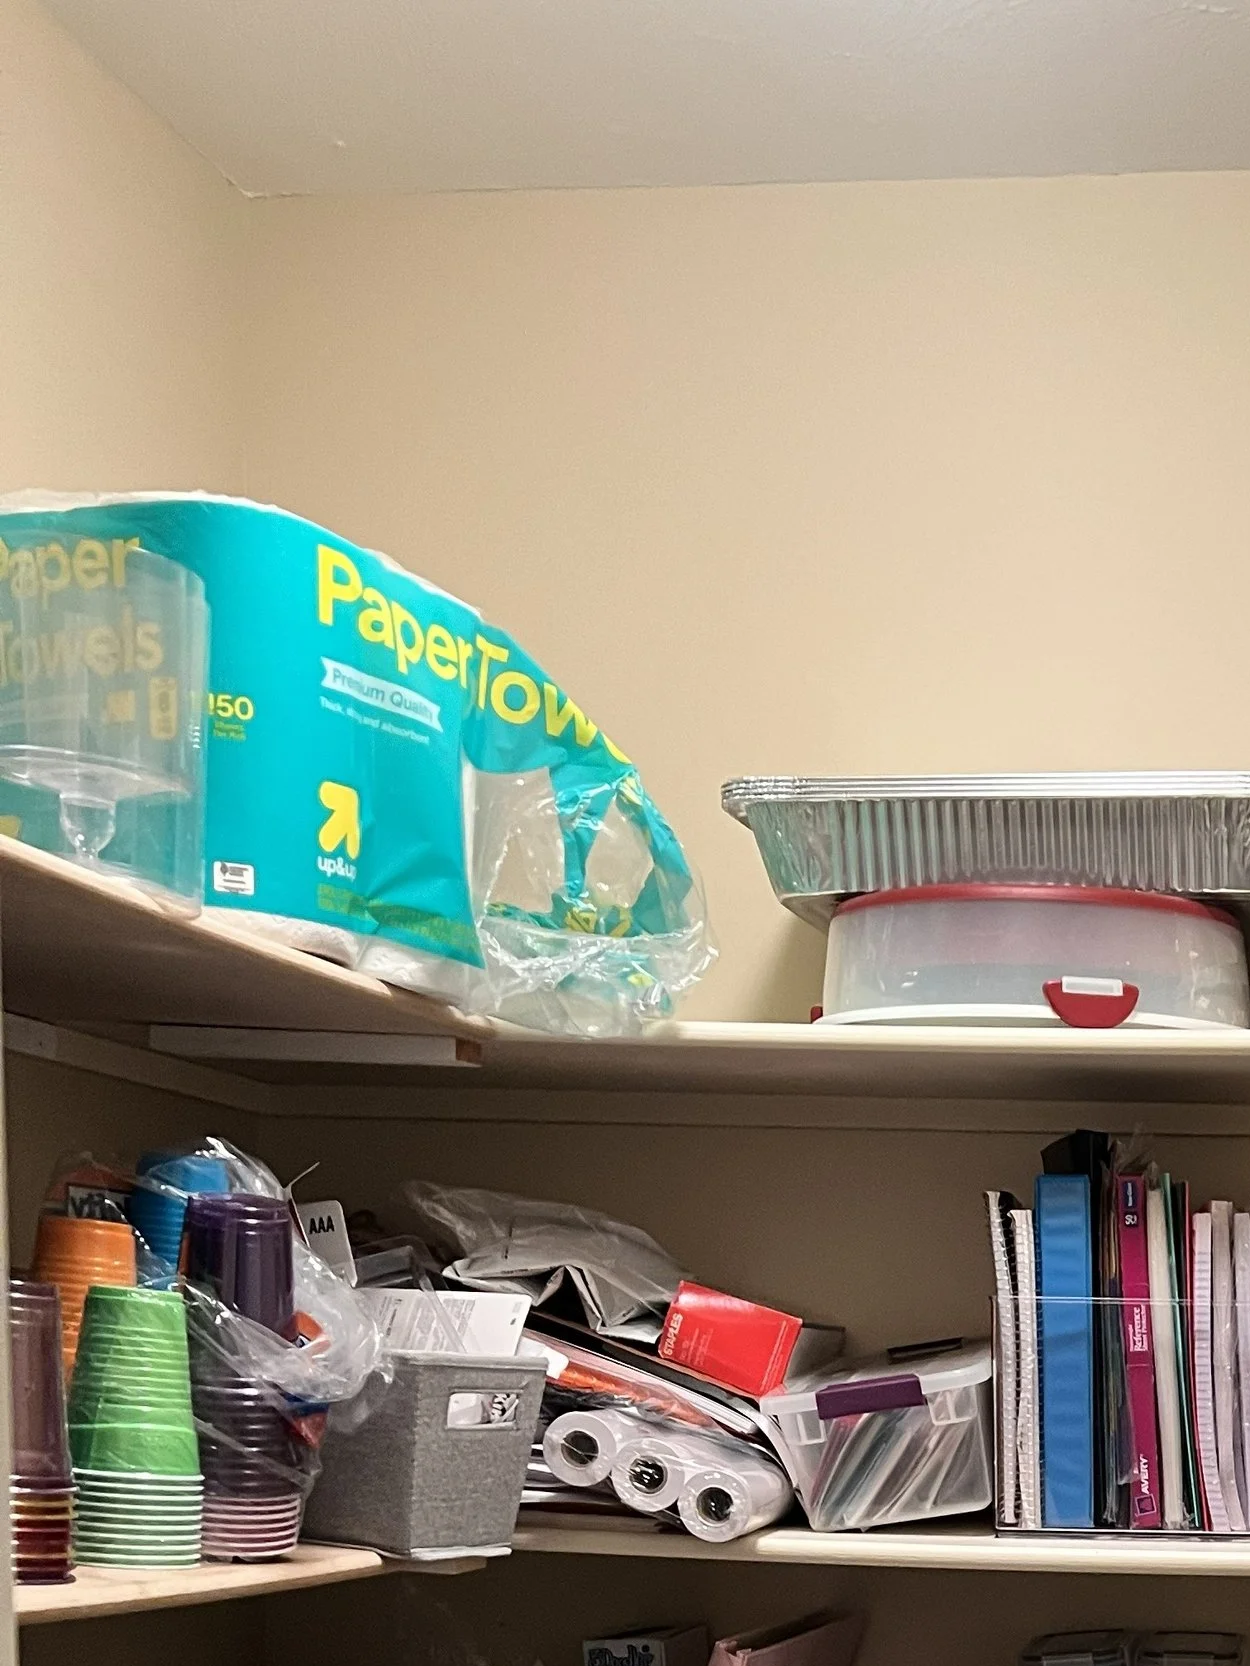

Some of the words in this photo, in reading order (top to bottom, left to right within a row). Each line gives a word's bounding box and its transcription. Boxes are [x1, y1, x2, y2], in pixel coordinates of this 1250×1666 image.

[318, 544, 473, 689] Paper
[309, 1215, 335, 1235] AAA
[663, 1312, 684, 1356] STAPLES
[1140, 1453, 1150, 1495] AVERY
